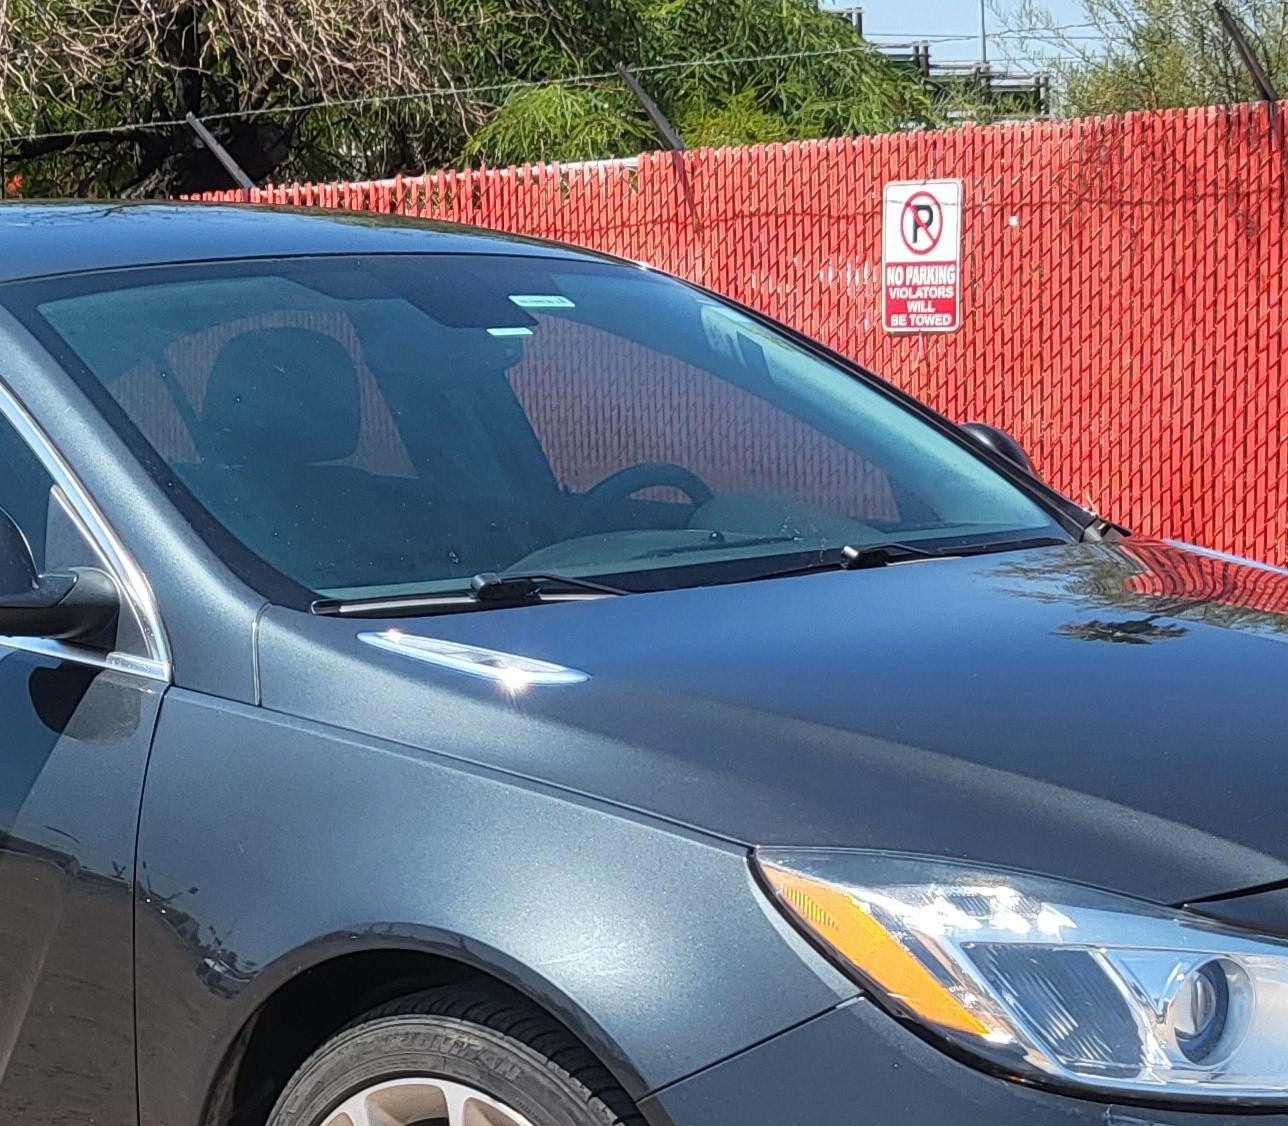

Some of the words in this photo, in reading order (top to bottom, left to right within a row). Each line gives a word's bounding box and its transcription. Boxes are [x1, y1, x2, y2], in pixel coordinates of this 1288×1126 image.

[886, 265, 904, 286] NO
[905, 264, 956, 286] PARKING
[888, 286, 954, 299] VIOLATORS
[906, 300, 936, 312] WILL
[890, 313, 907, 326] BE
[908, 313, 952, 326] TOWED
